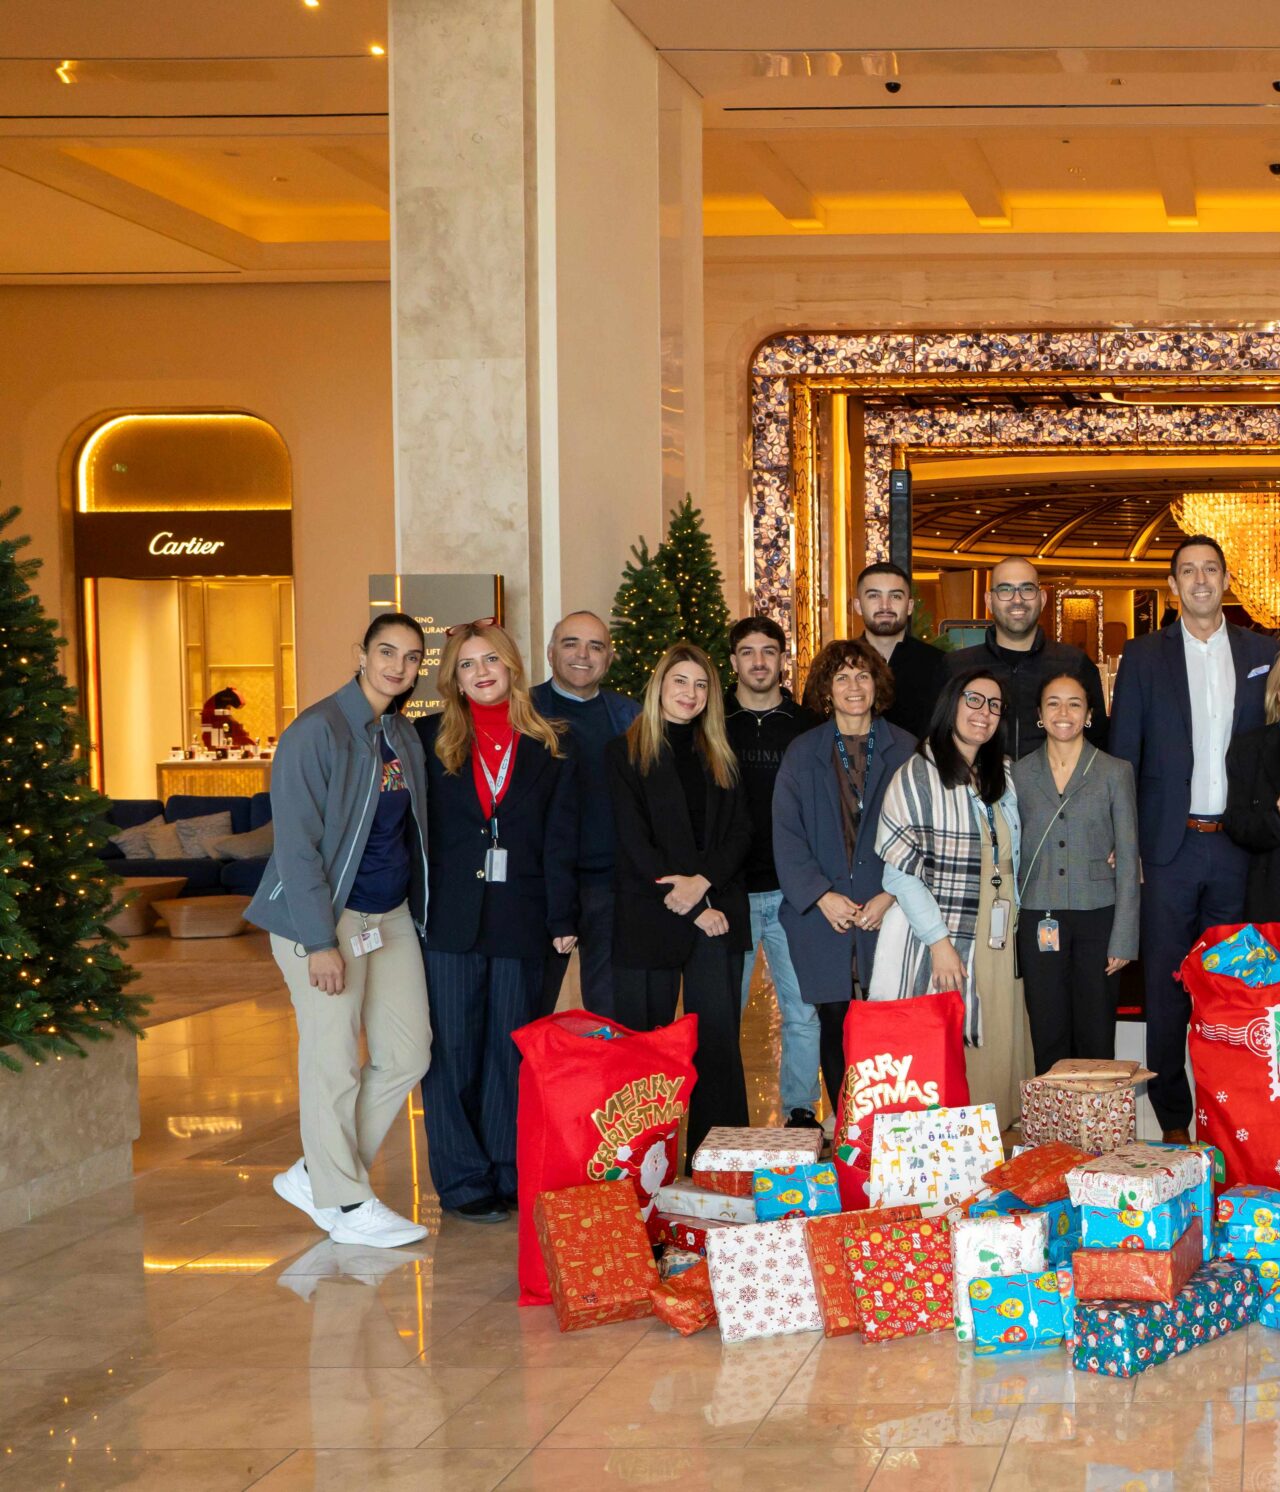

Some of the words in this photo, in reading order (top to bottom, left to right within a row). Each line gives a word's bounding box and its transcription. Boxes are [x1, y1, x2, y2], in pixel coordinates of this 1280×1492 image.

[148, 531, 225, 555] Cartier
[426, 648, 440, 656] LIFT
[406, 700, 424, 708] EAST
[425, 700, 440, 708] LIFT
[591, 1073, 686, 1139] MERRY
[587, 1101, 687, 1181] CHRISTMA
